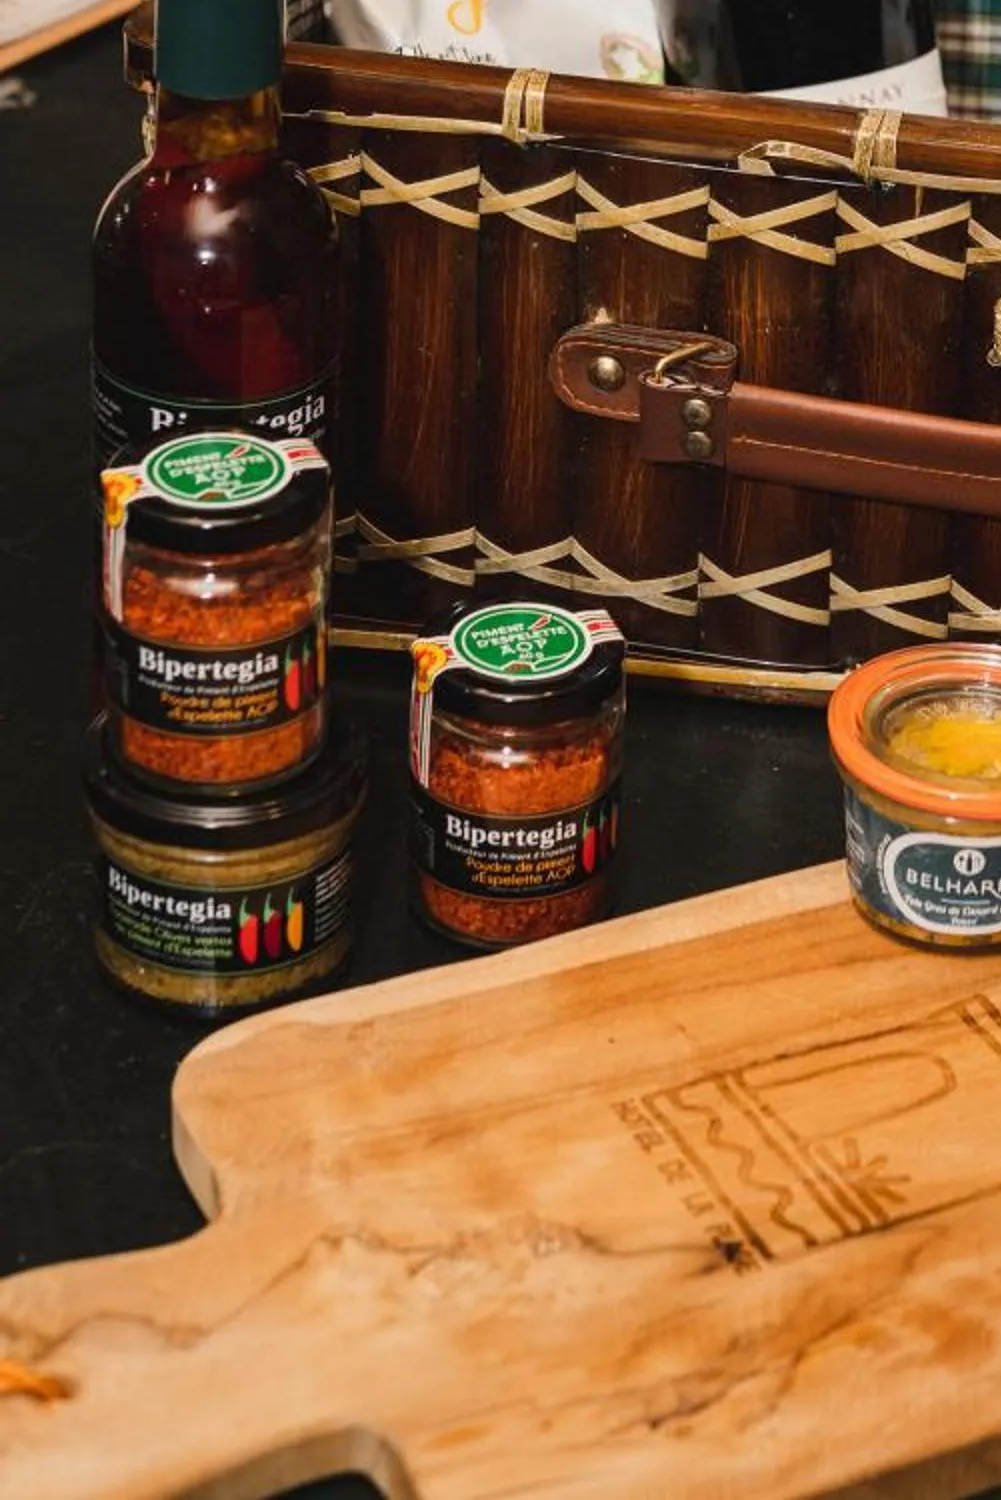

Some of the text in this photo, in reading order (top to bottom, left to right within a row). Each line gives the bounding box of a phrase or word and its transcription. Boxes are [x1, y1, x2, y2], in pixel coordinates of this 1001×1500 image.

[138, 645, 279, 684] Bipertegia
[446, 813, 577, 850] Bipertegia
[109, 866, 231, 924] Bipertegia
